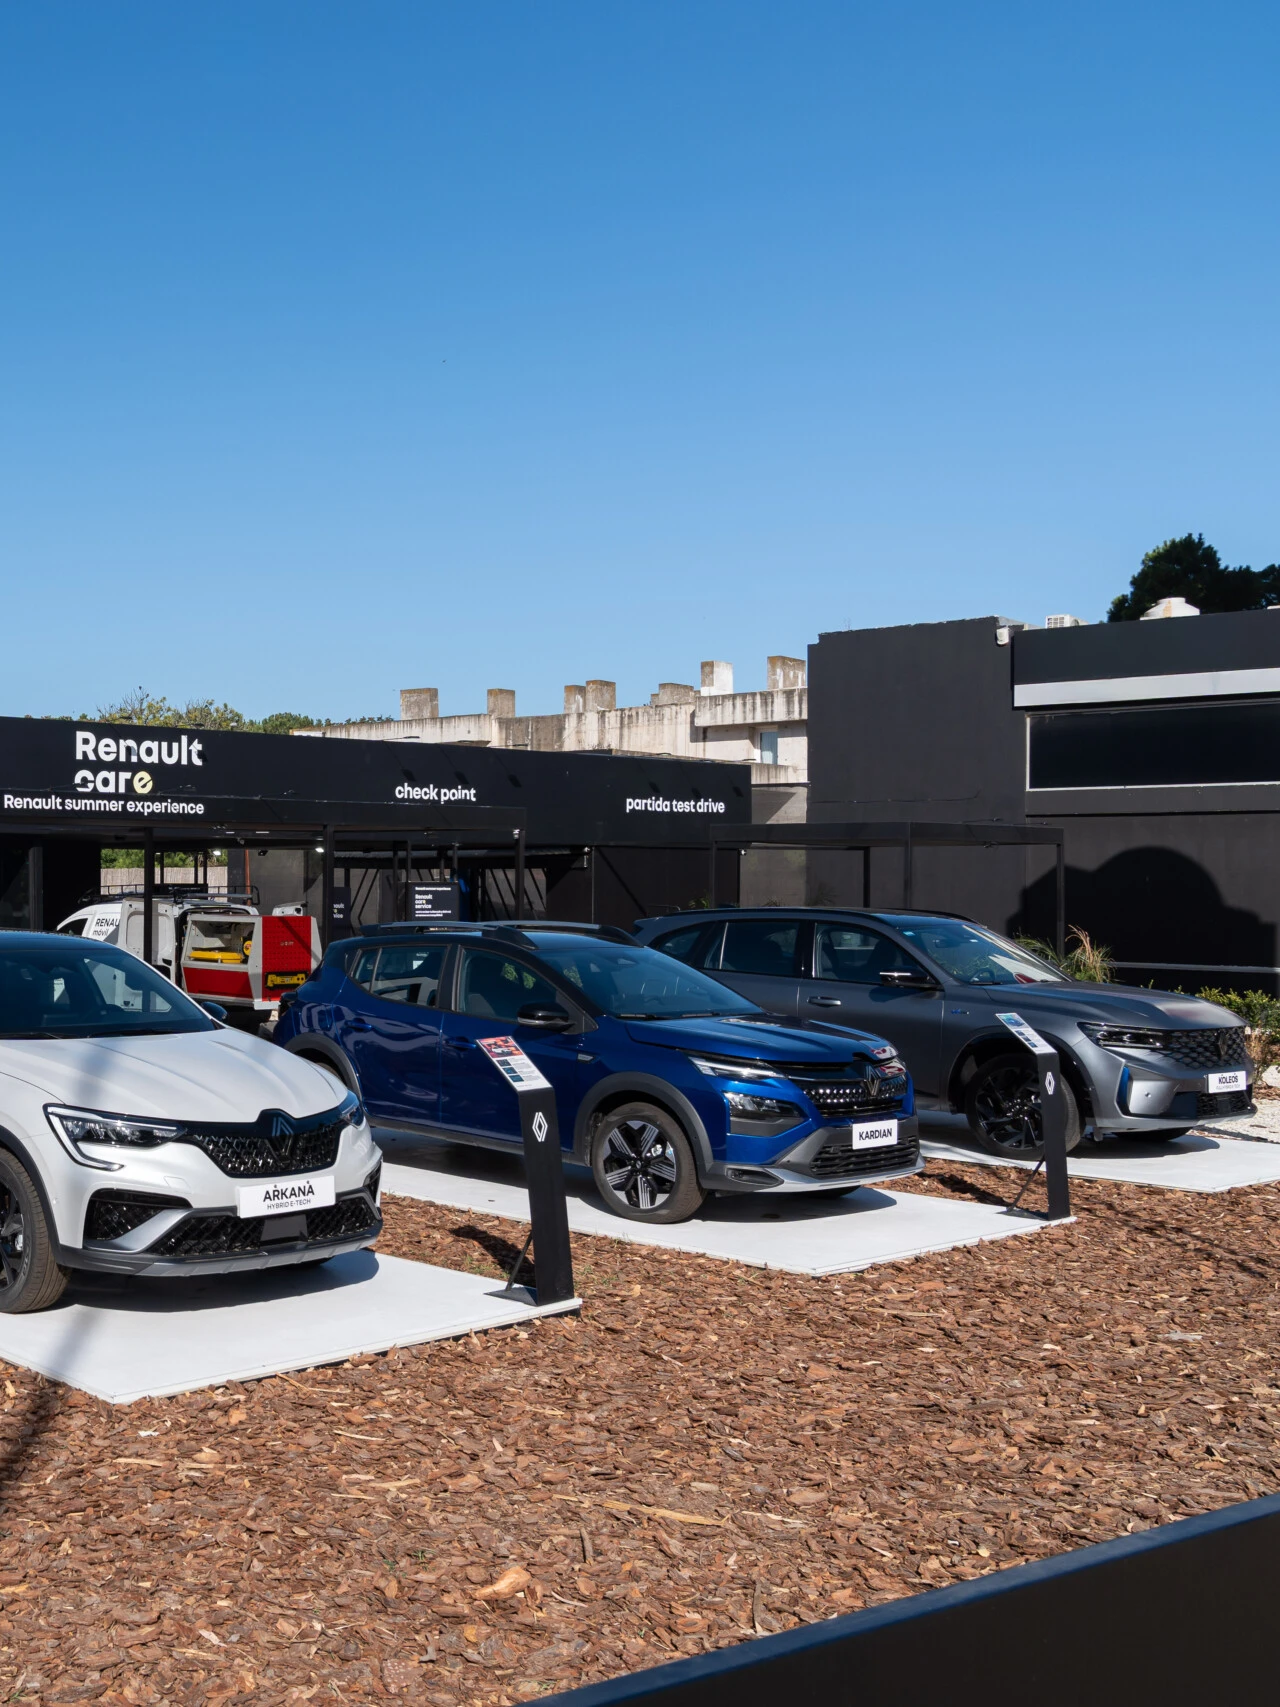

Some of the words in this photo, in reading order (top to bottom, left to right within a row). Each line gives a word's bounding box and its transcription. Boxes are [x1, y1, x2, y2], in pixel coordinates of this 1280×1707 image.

[75, 730, 203, 766] Renault
[73, 769, 153, 794] care
[394, 782, 438, 800] check
[440, 785, 476, 804] point
[3, 794, 62, 810] Renault
[64, 798, 125, 812] summer
[126, 799, 204, 816] experience
[626, 796, 670, 814] partida
[672, 798, 695, 813] test
[696, 798, 725, 814] drive
[1219, 1076, 1238, 1084] KOLEOS
[859, 1128, 892, 1140] KARDIAN
[263, 1185, 315, 1202] ARKANA
[267, 1201, 289, 1210] HYBRID
